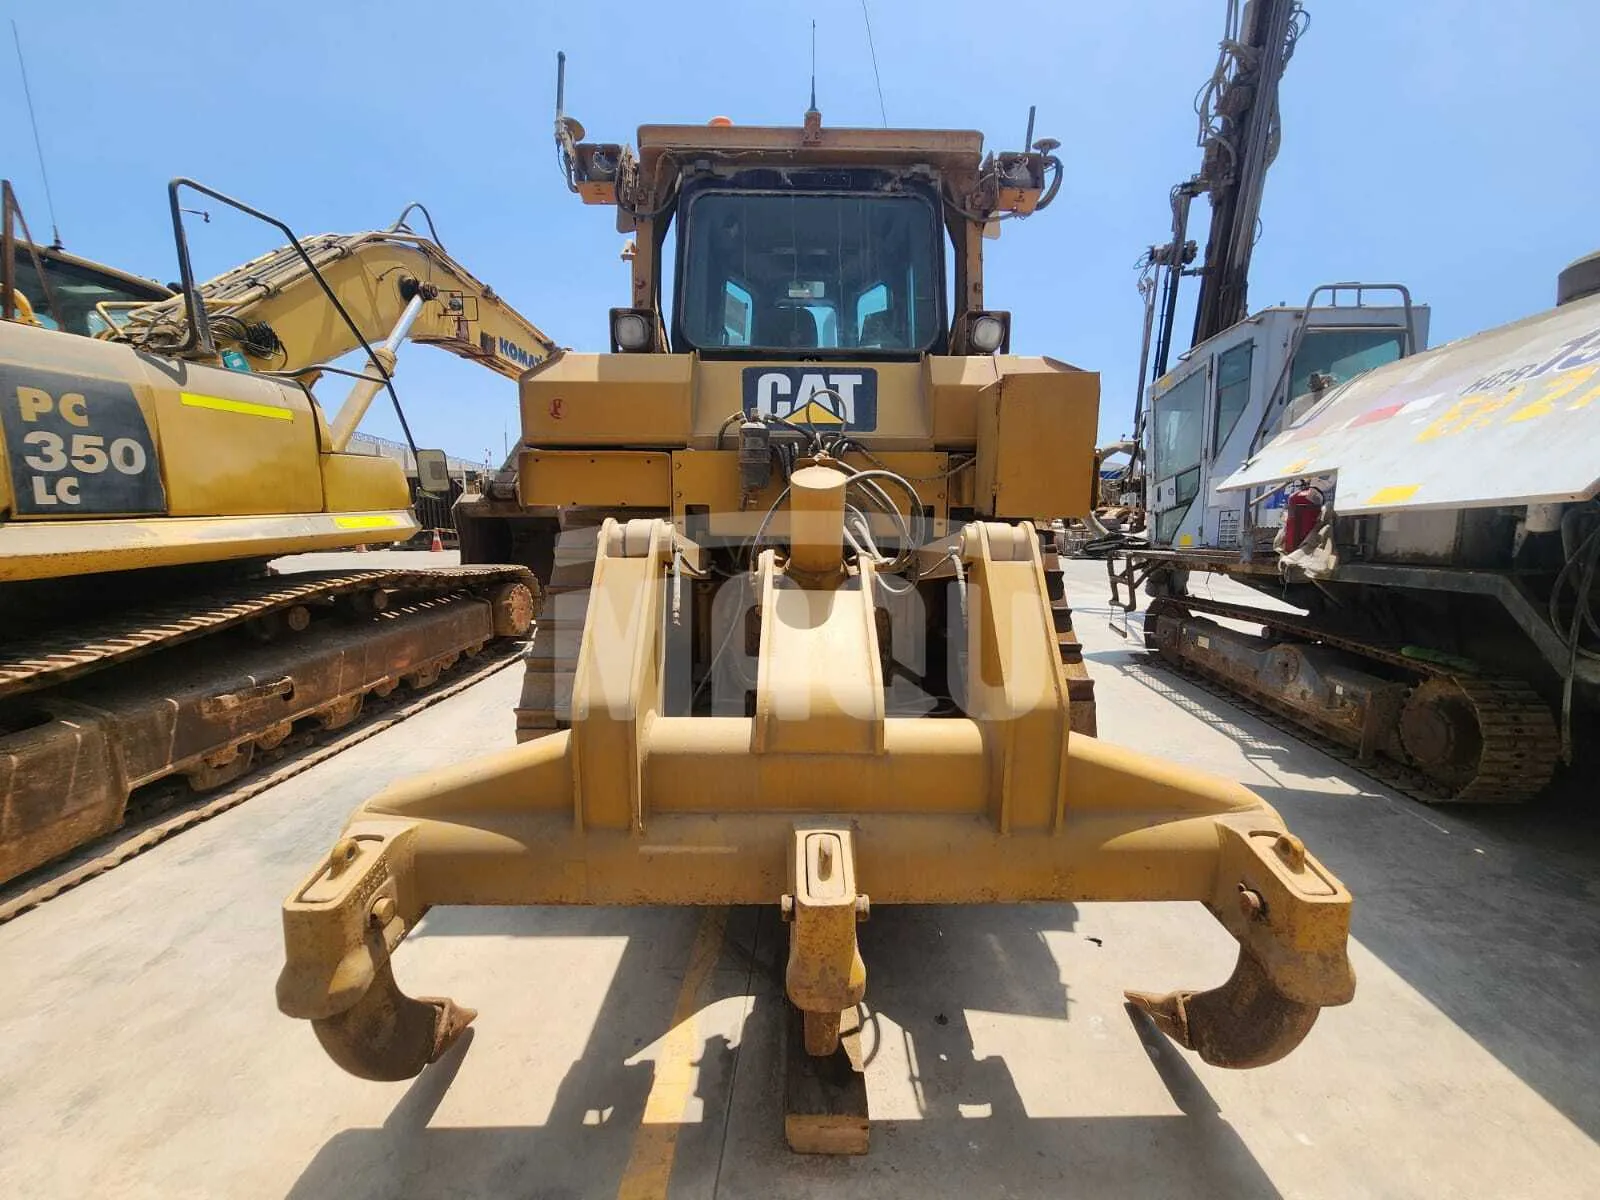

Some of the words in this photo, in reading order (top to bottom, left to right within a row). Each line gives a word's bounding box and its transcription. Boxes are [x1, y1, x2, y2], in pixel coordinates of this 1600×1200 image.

[16, 386, 89, 427] PC
[757, 372, 862, 424] CAT
[23, 430, 147, 475] 350
[32, 476, 81, 504] LC
